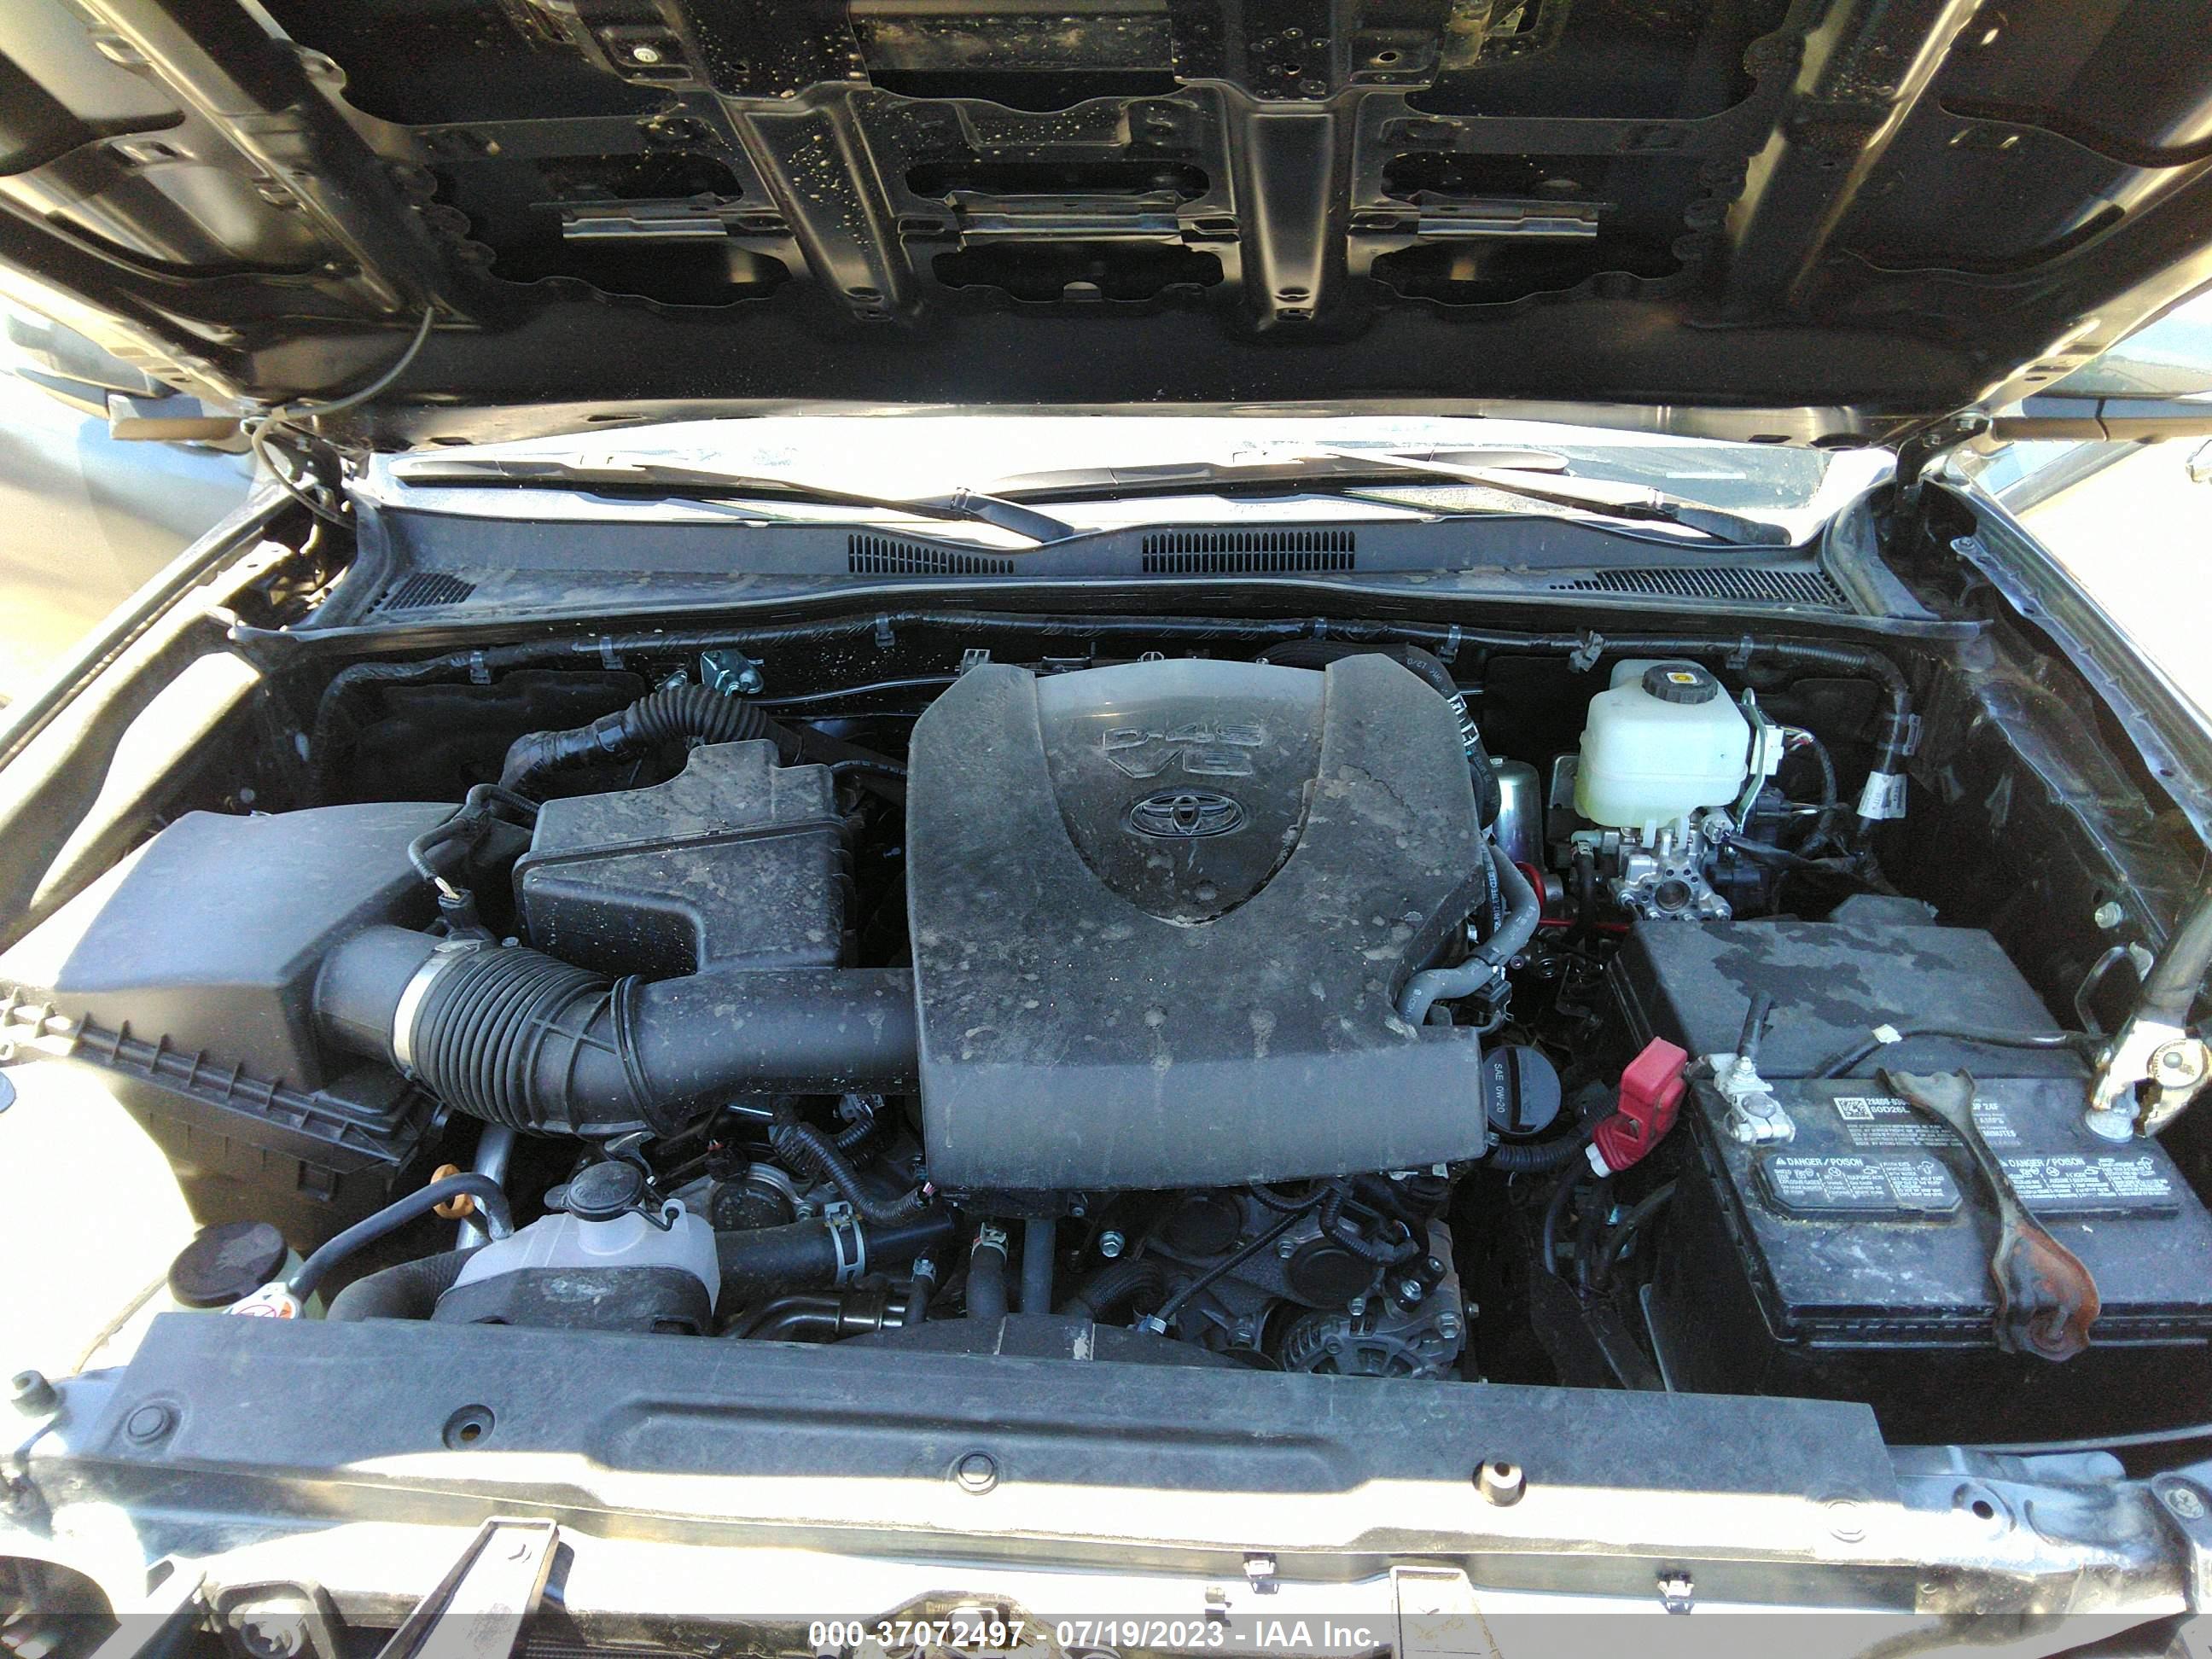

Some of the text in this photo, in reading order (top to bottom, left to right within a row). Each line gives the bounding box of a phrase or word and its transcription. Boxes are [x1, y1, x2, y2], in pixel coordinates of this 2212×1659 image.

[1107, 748, 1254, 778] V6
[1493, 1063, 1505, 1113] SAE 0W-20
[1786, 1157, 1822, 1167] DANGER
[1830, 1158, 1864, 1167] POISON
[2008, 1158, 2045, 1167] DANGER
[2051, 1158, 2086, 1167] POISON
